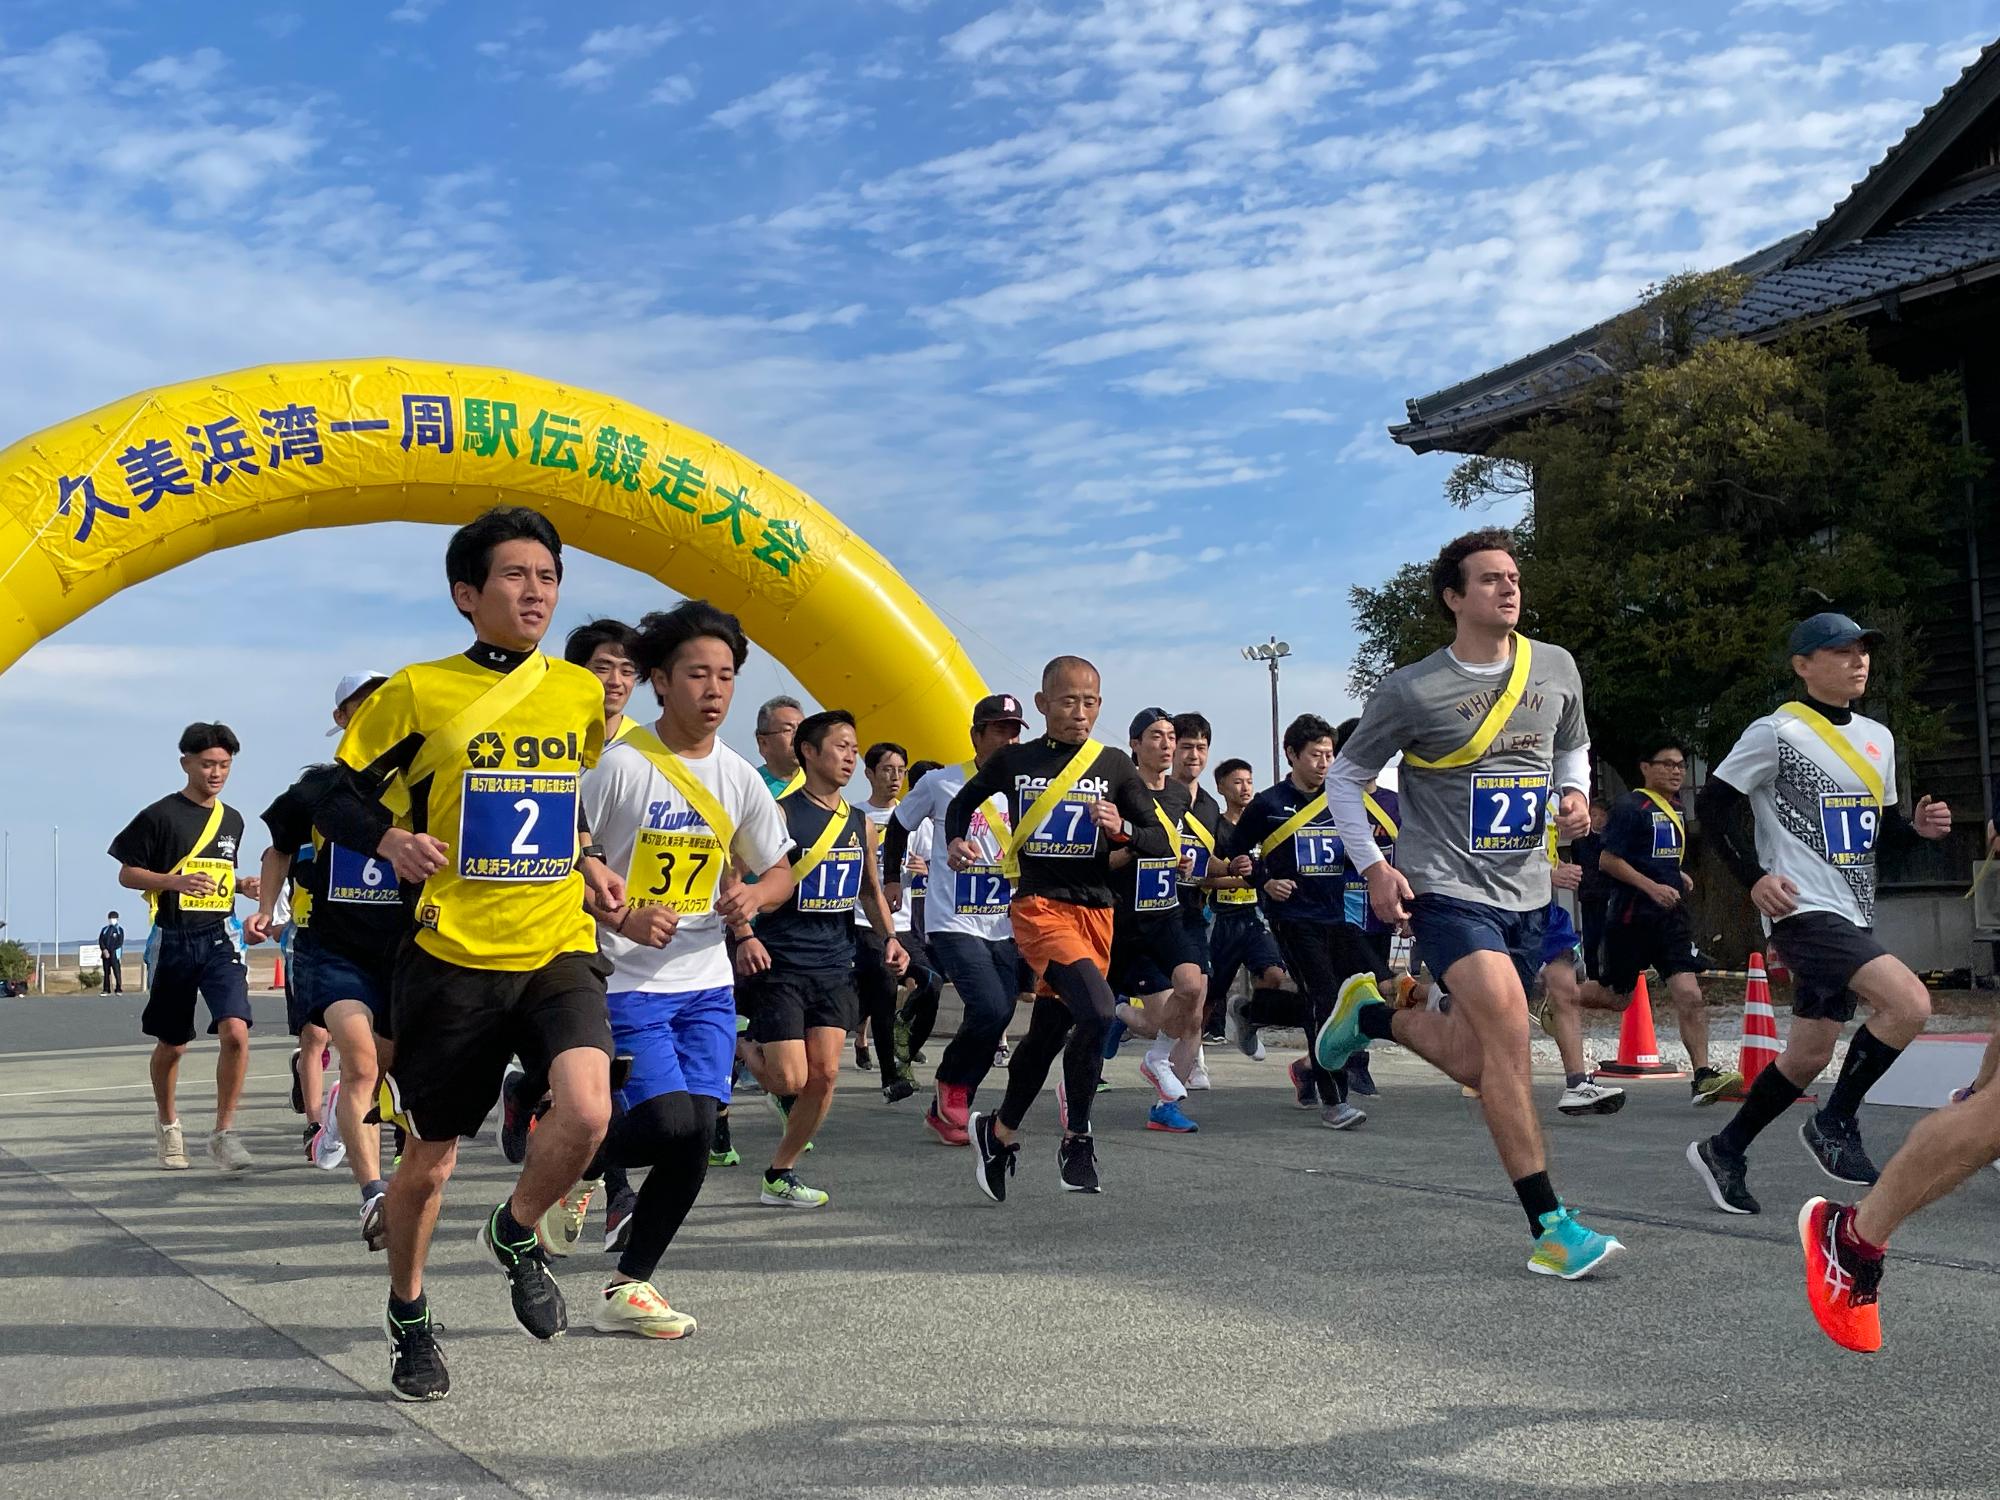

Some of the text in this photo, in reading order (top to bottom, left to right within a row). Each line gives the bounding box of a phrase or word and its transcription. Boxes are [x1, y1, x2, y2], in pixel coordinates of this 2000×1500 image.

[57, 393, 810, 577] 久美浜湾一周駅伝競走大会
[1456, 687, 1544, 721] WHITAN
[1015, 774, 1109, 793] Reok
[511, 798, 540, 854] 2
[1033, 804, 1084, 841] 27
[1490, 791, 1538, 834] 23
[1669, 822, 1676, 847] 1
[1840, 810, 1876, 850] 19
[1308, 838, 1335, 864] 15
[362, 857, 383, 887] 6
[648, 851, 710, 896] 37
[818, 863, 850, 897] 17
[1157, 869, 1170, 897] 5
[969, 875, 1001, 905] 12
